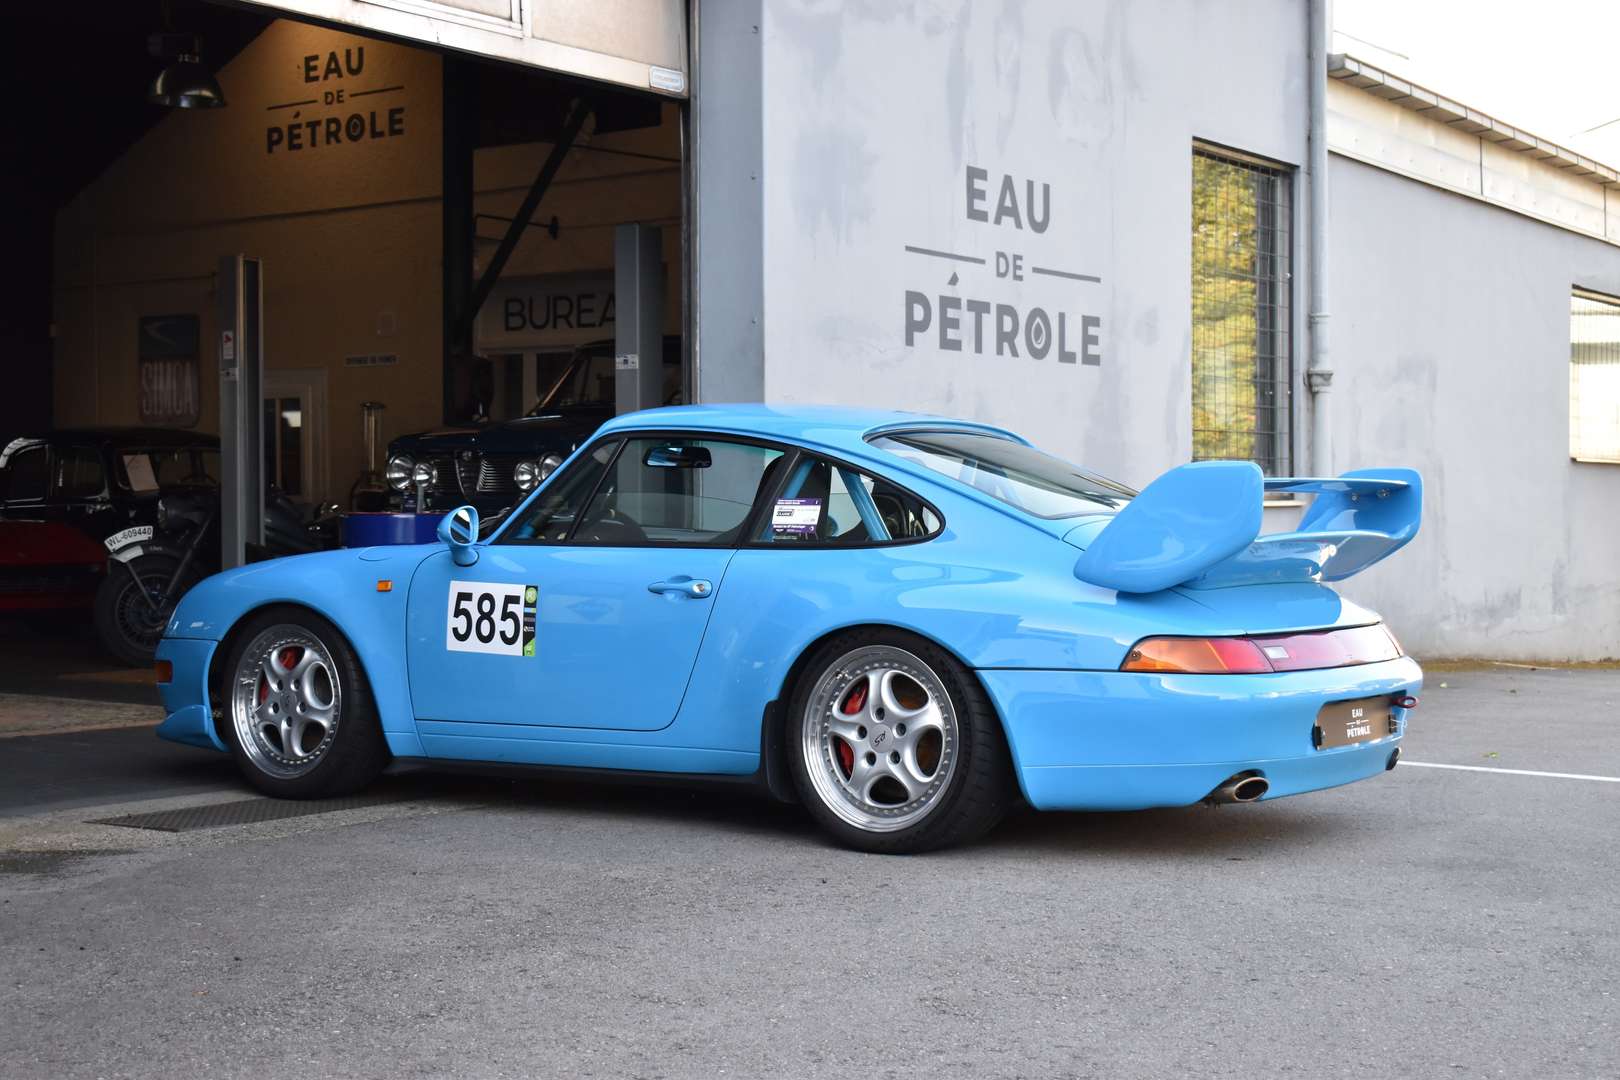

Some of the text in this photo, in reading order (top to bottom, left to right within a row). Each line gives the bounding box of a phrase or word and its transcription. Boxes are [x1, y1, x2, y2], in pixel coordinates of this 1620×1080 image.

[304, 47, 364, 83] EAU
[324, 89, 345, 105] DE
[266, 107, 405, 154] PÉTROLE
[966, 164, 1051, 235] EAU
[995, 250, 1024, 282] DE
[904, 271, 1102, 367] PÉTROLE
[142, 360, 196, 416] SIMCA
[452, 591, 521, 646] 585
[1351, 707, 1363, 718] EAU
